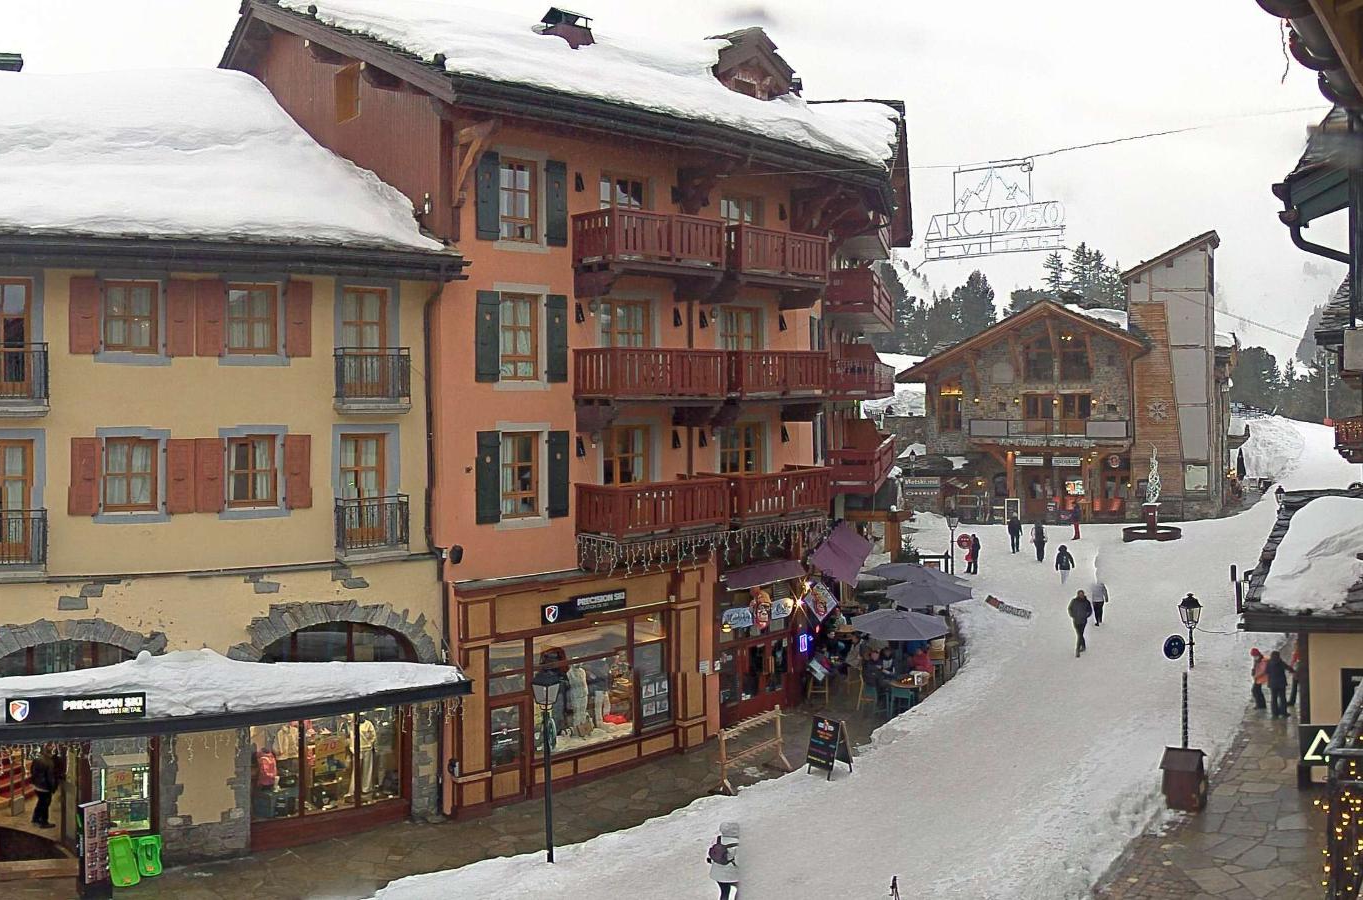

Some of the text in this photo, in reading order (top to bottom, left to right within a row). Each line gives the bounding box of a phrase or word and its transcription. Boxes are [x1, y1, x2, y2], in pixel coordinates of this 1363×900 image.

[925, 201, 1065, 240] ARC 1950
[62, 697, 143, 711] PRECISION SKI
